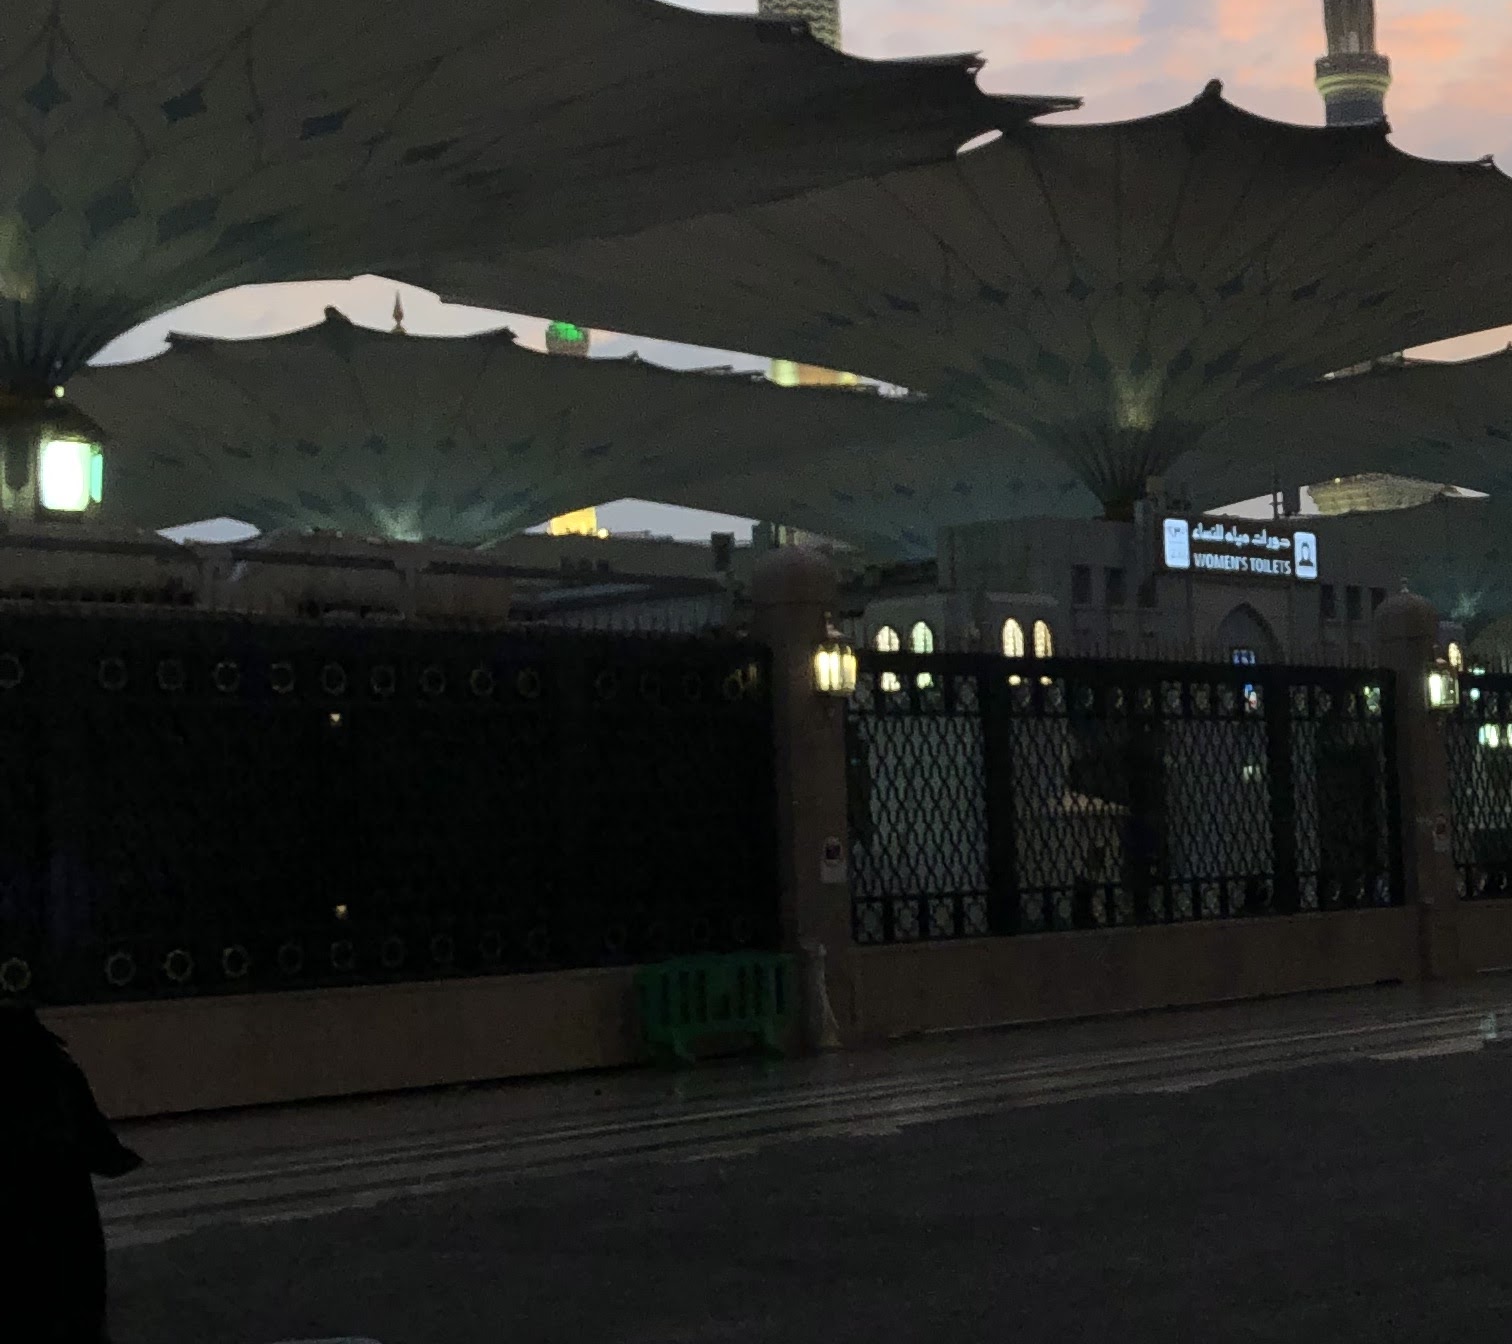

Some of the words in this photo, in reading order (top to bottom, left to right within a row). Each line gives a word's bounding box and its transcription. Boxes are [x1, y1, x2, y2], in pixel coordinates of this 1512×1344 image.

[1225, 525, 1250, 548] مياه
[1251, 528, 1291, 550] دورات
[1193, 552, 1248, 571] WOMEN'S
[1249, 557, 1292, 575] TOILETS
